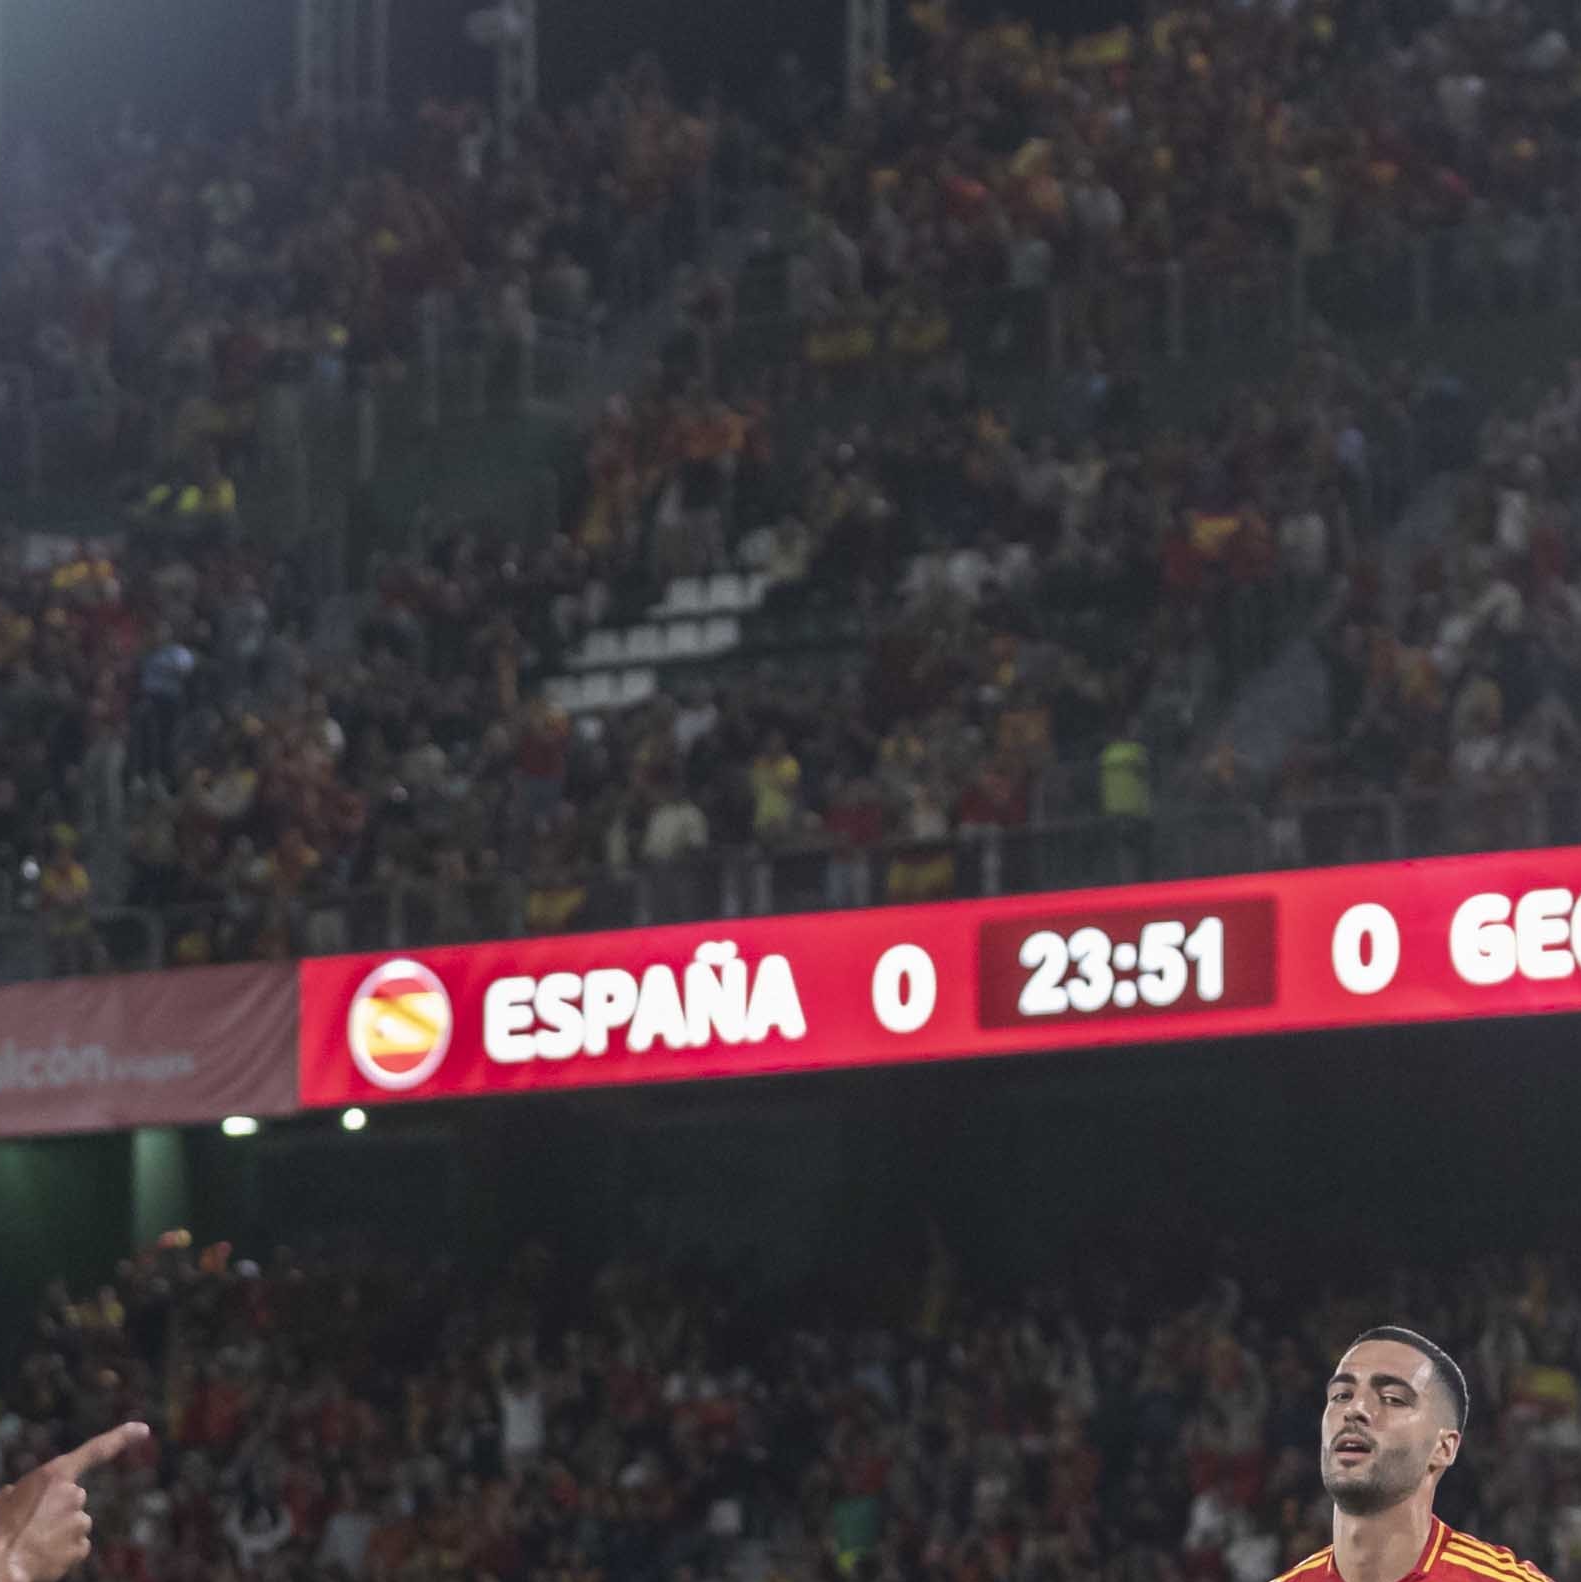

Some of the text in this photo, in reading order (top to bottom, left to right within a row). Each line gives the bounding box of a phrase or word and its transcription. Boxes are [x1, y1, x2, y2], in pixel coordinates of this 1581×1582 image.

[482, 940, 808, 1064] ESPAÑA
[871, 943, 938, 1034] 0
[1018, 916, 1224, 1017] 23:51
[1331, 902, 1401, 995] 0
